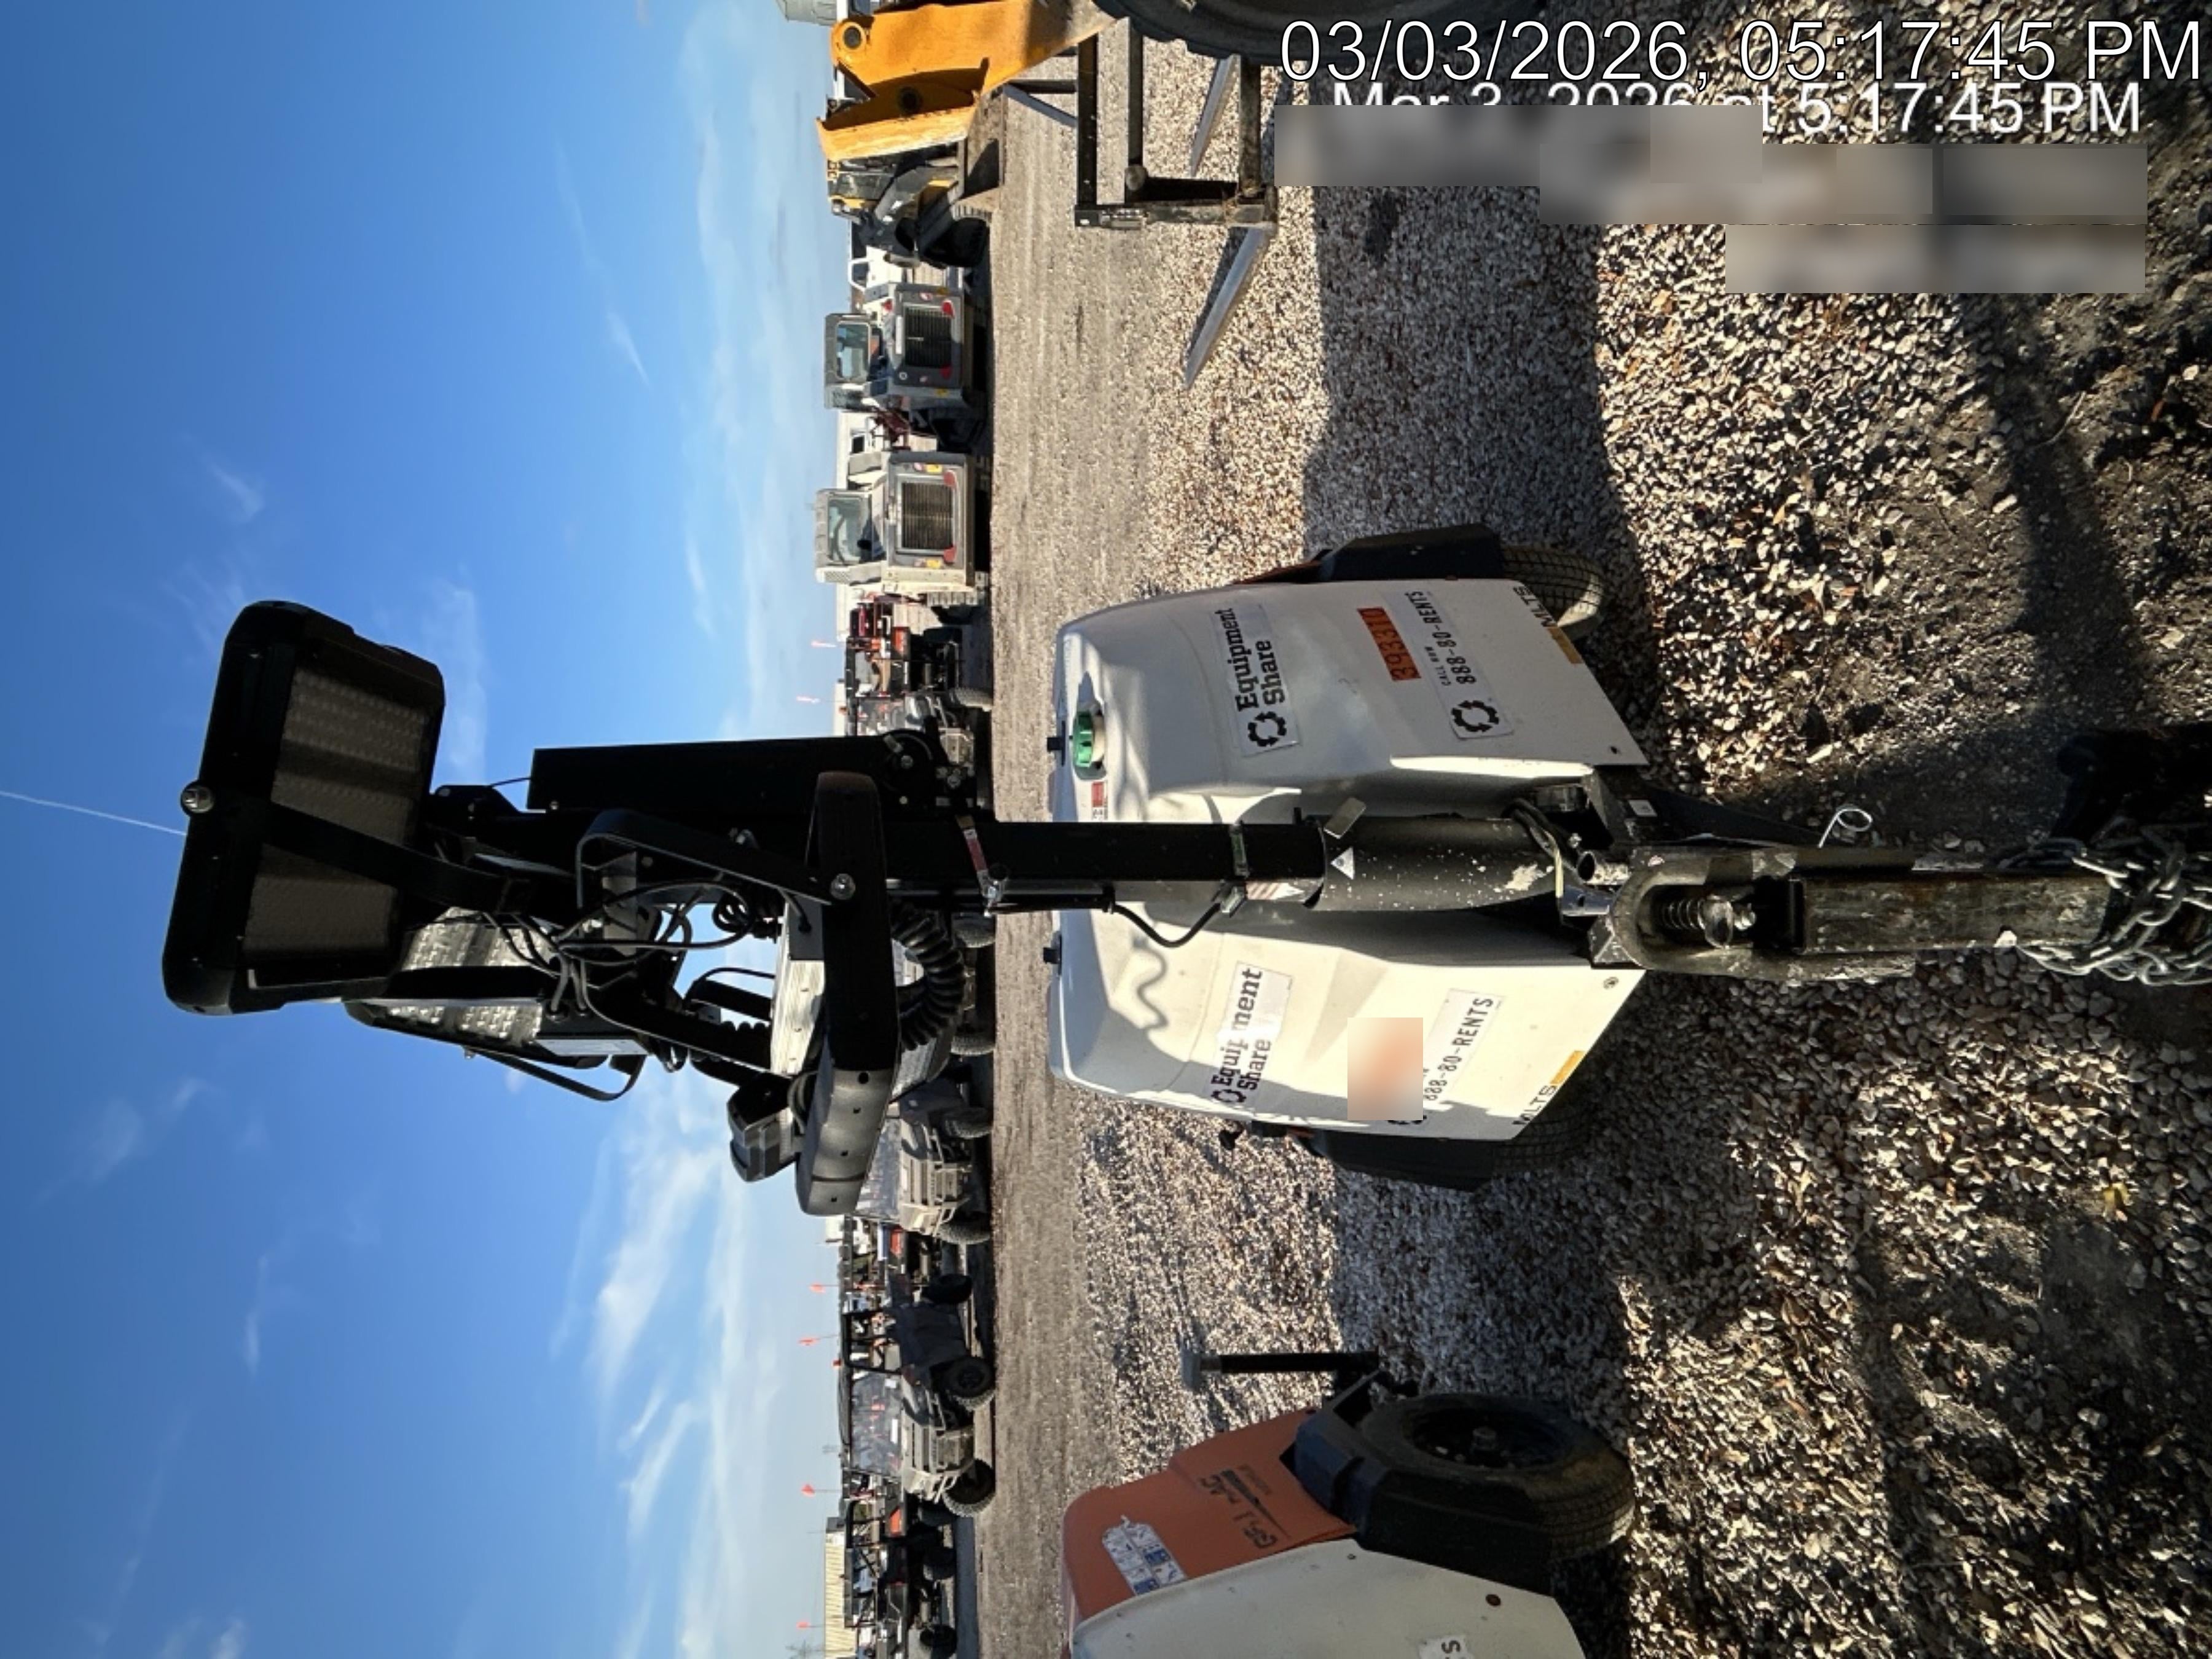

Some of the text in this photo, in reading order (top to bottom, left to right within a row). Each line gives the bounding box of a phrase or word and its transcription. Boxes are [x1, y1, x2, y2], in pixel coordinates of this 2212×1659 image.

[1215, 608, 1260, 712] Equipment
[1255, 640, 1285, 705] Share
[1405, 590, 1477, 684] 888-80-RENTS
[1236, 1039, 1272, 1091] Share
[1422, 998, 1494, 1101] 888-80-RENTS
